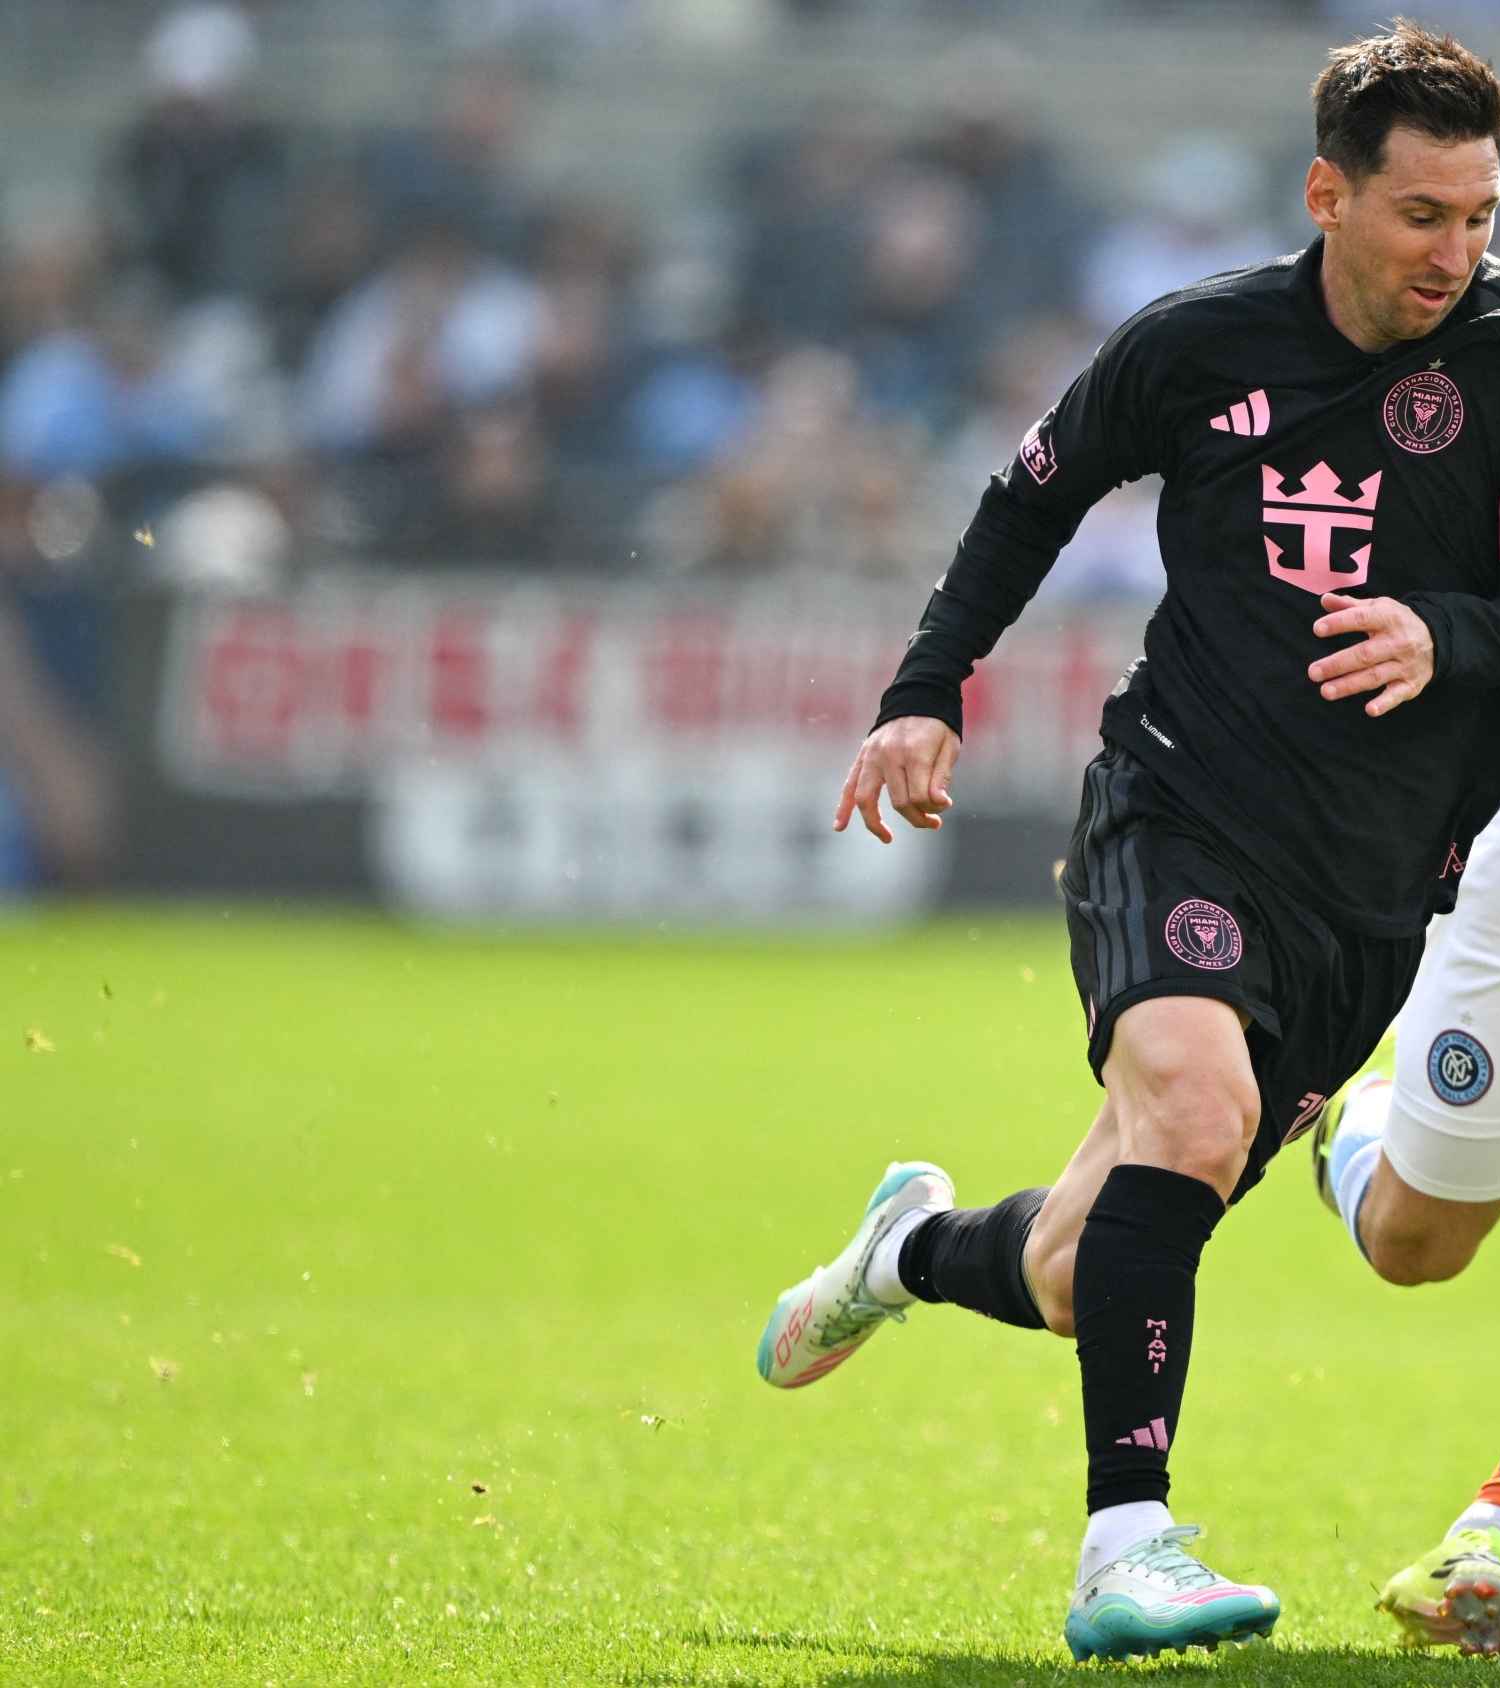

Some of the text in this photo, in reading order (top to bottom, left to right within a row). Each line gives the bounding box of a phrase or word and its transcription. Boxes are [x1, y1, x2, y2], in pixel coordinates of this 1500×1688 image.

[1391, 375, 1453, 402] INTERNACIONAL
[1412, 391, 1443, 403] MIAMI
[1387, 405, 1397, 428] CLUB
[1189, 917, 1219, 927] MIAMI
[1147, 1318, 1167, 1374] MIAMI
